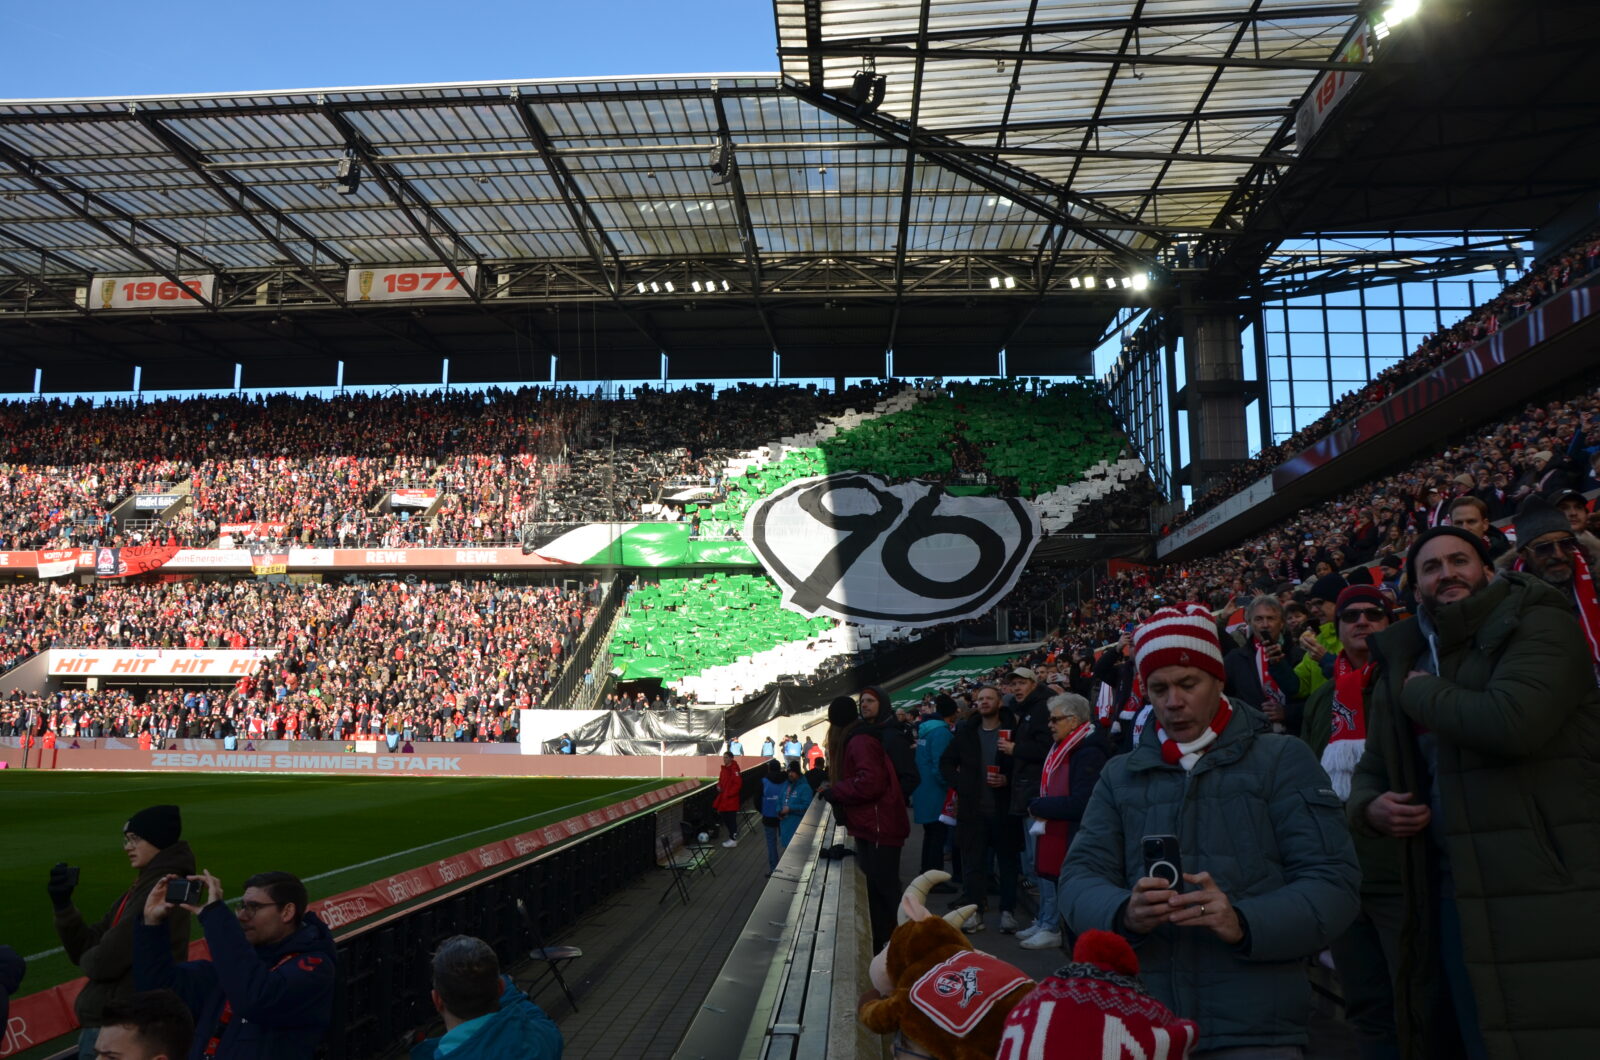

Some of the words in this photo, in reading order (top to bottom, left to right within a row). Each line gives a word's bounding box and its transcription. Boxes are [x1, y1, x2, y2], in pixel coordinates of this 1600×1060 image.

[123, 280, 202, 301] 1968
[384, 272, 464, 293] 1977
[791, 473, 1006, 613] 96
[366, 551, 407, 563] REWE
[456, 551, 497, 563] REWE
[54, 658, 99, 673] HIT
[112, 658, 156, 673] HIT
[170, 658, 215, 673] HIT
[228, 659, 262, 673] HI
[151, 754, 272, 768] ZESAMME
[275, 754, 375, 770] SIMMER
[377, 756, 462, 771] STARK
[387, 876, 424, 903] DERTOUR
[320, 897, 371, 930] DERTOUR
